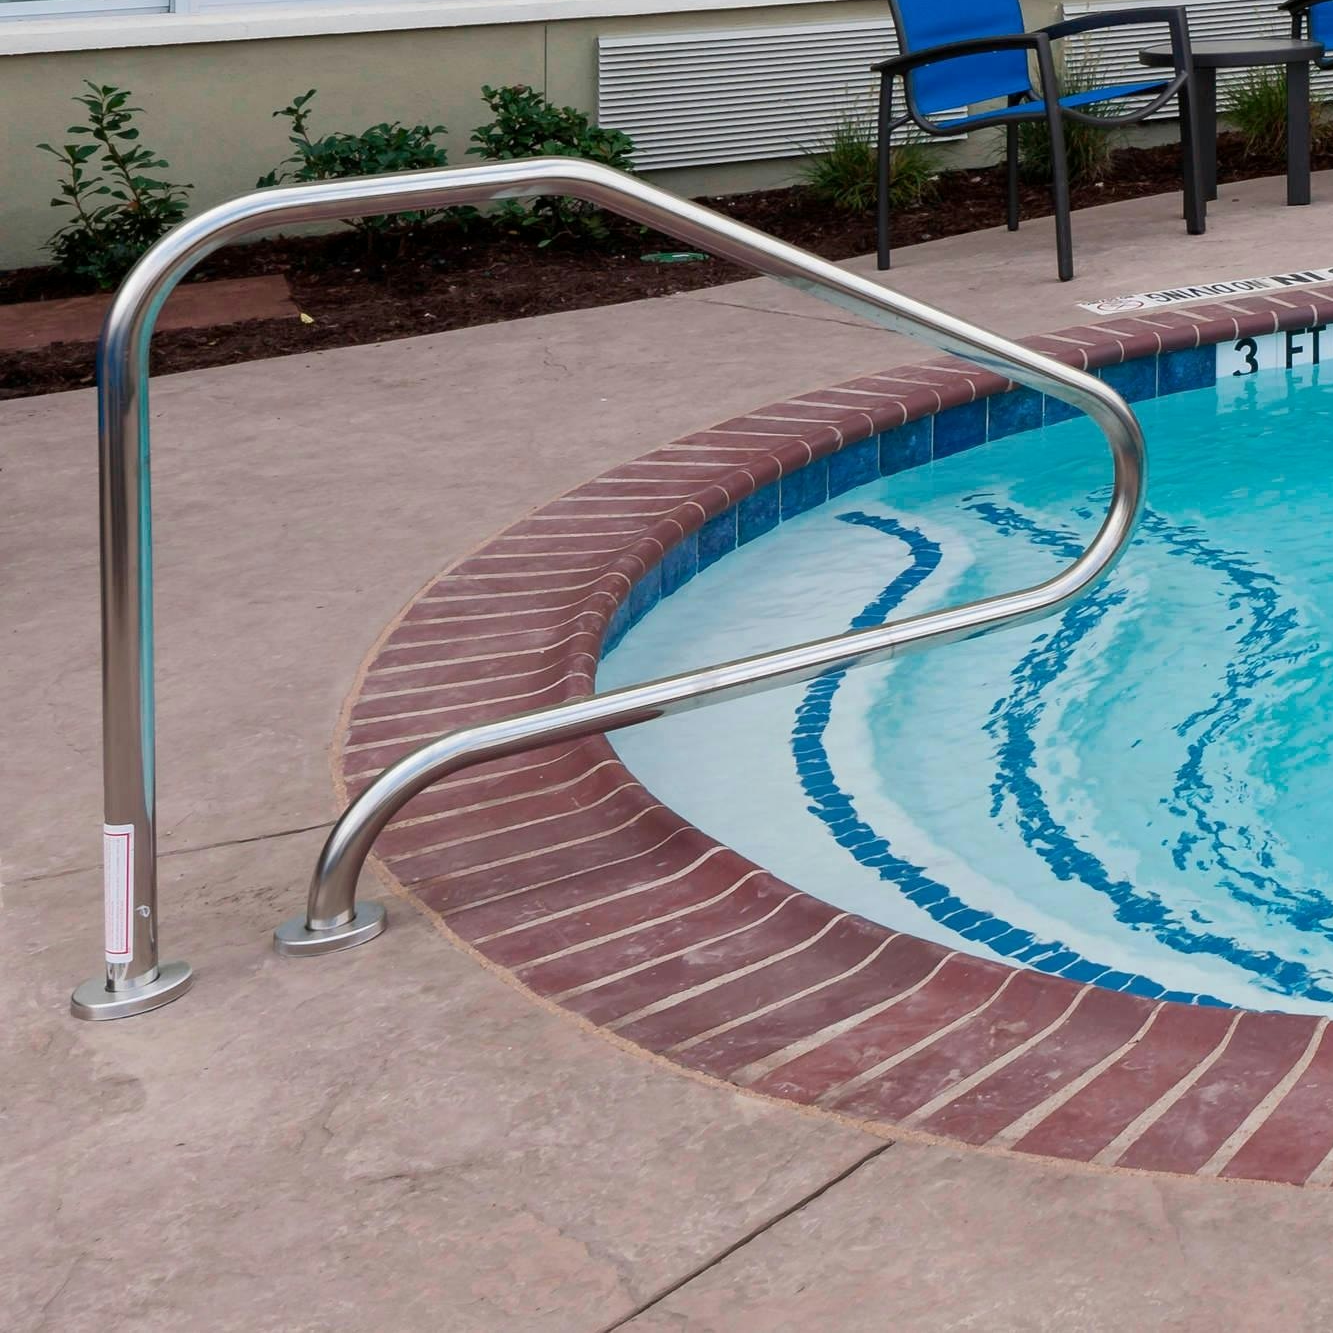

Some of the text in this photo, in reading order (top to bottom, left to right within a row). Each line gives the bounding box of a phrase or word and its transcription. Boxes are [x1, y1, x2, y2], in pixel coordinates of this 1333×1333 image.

[1143, 284, 1238, 302] DIVING
[1233, 337, 1259, 376] 3
[1286, 325, 1327, 369] FT
